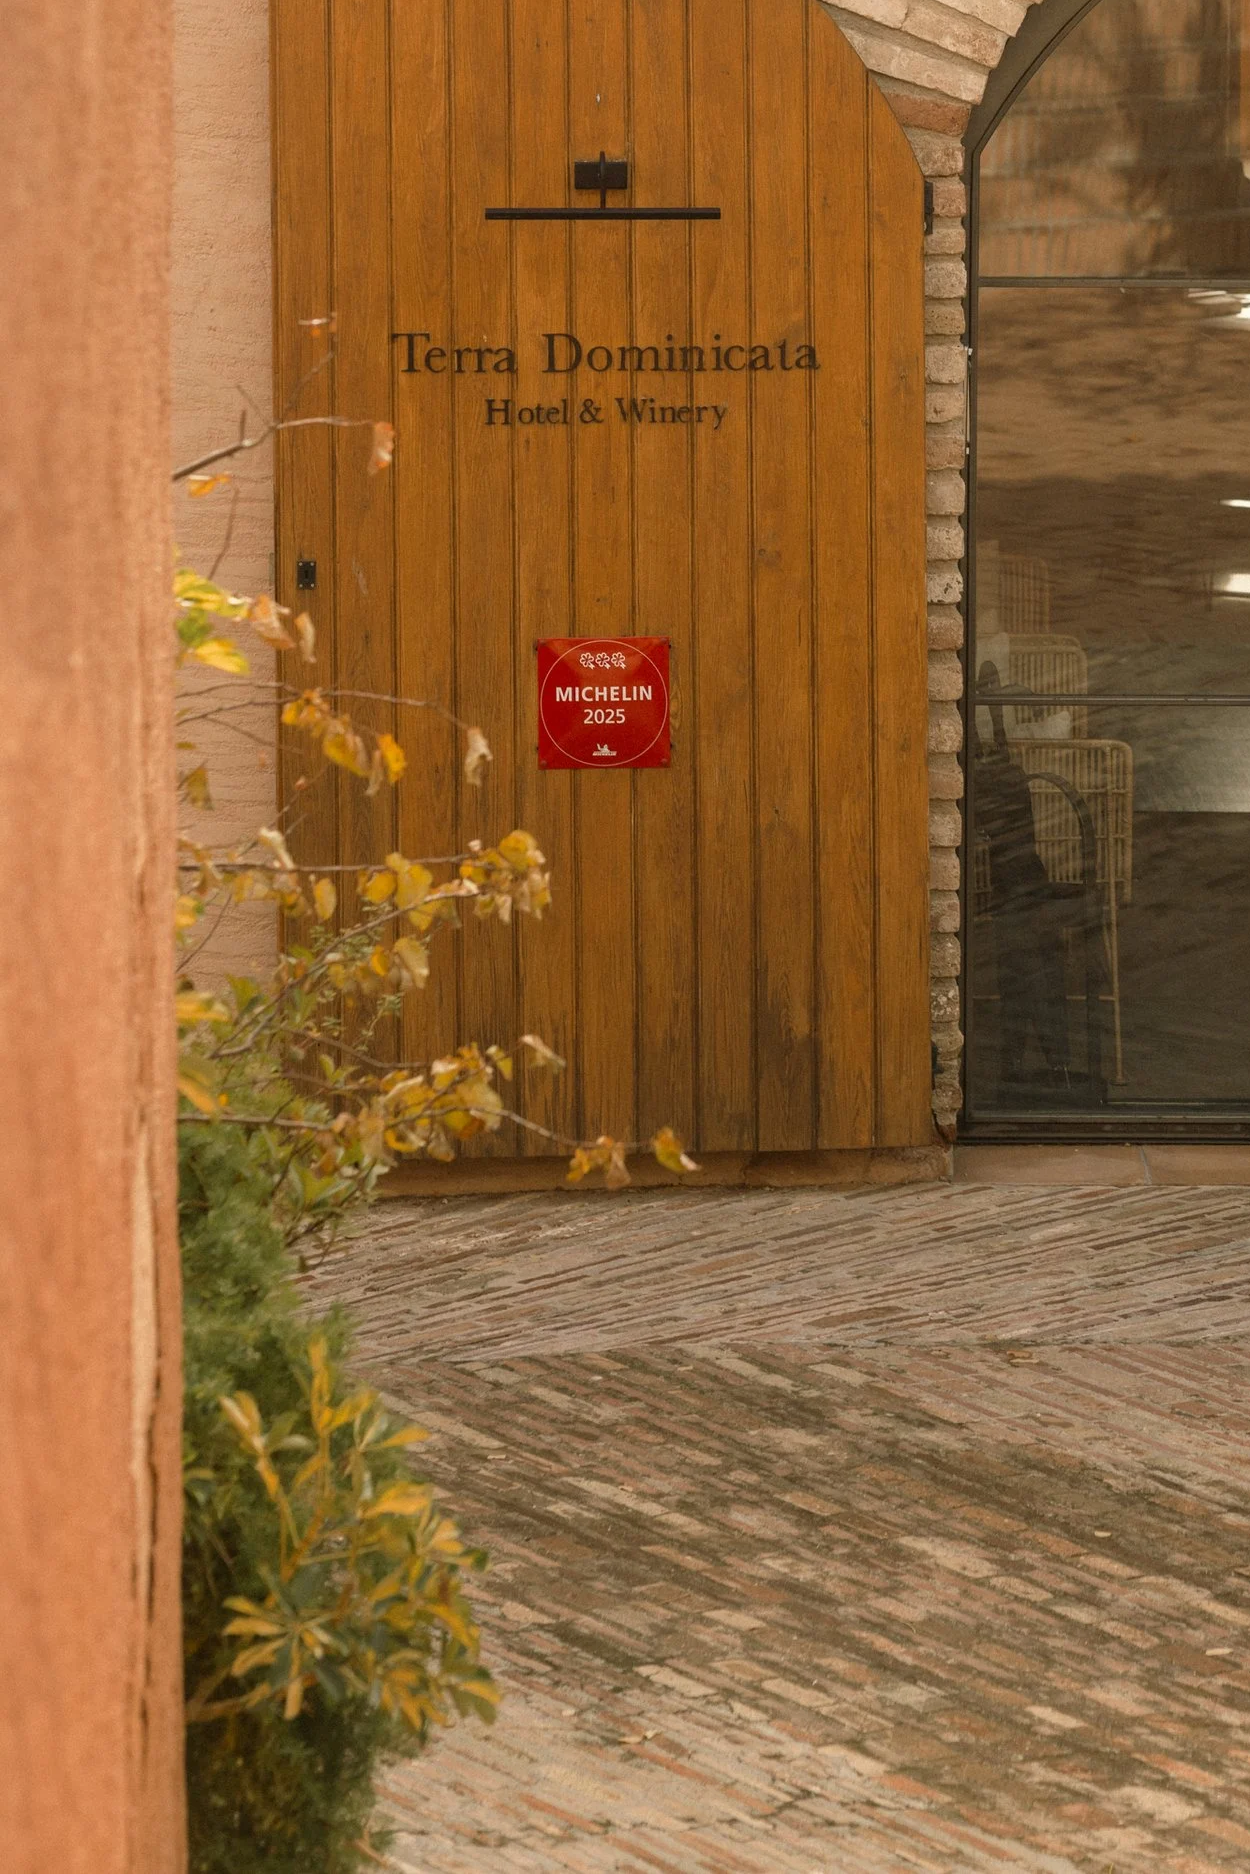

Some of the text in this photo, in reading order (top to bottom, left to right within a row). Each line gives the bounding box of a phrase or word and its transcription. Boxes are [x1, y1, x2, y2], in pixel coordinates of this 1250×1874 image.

[391, 332, 820, 374] Terra Dominicata
[484, 397, 728, 430] Hotel & Winery
[555, 685, 653, 702] MICHELIN
[583, 708, 626, 724] 2025
